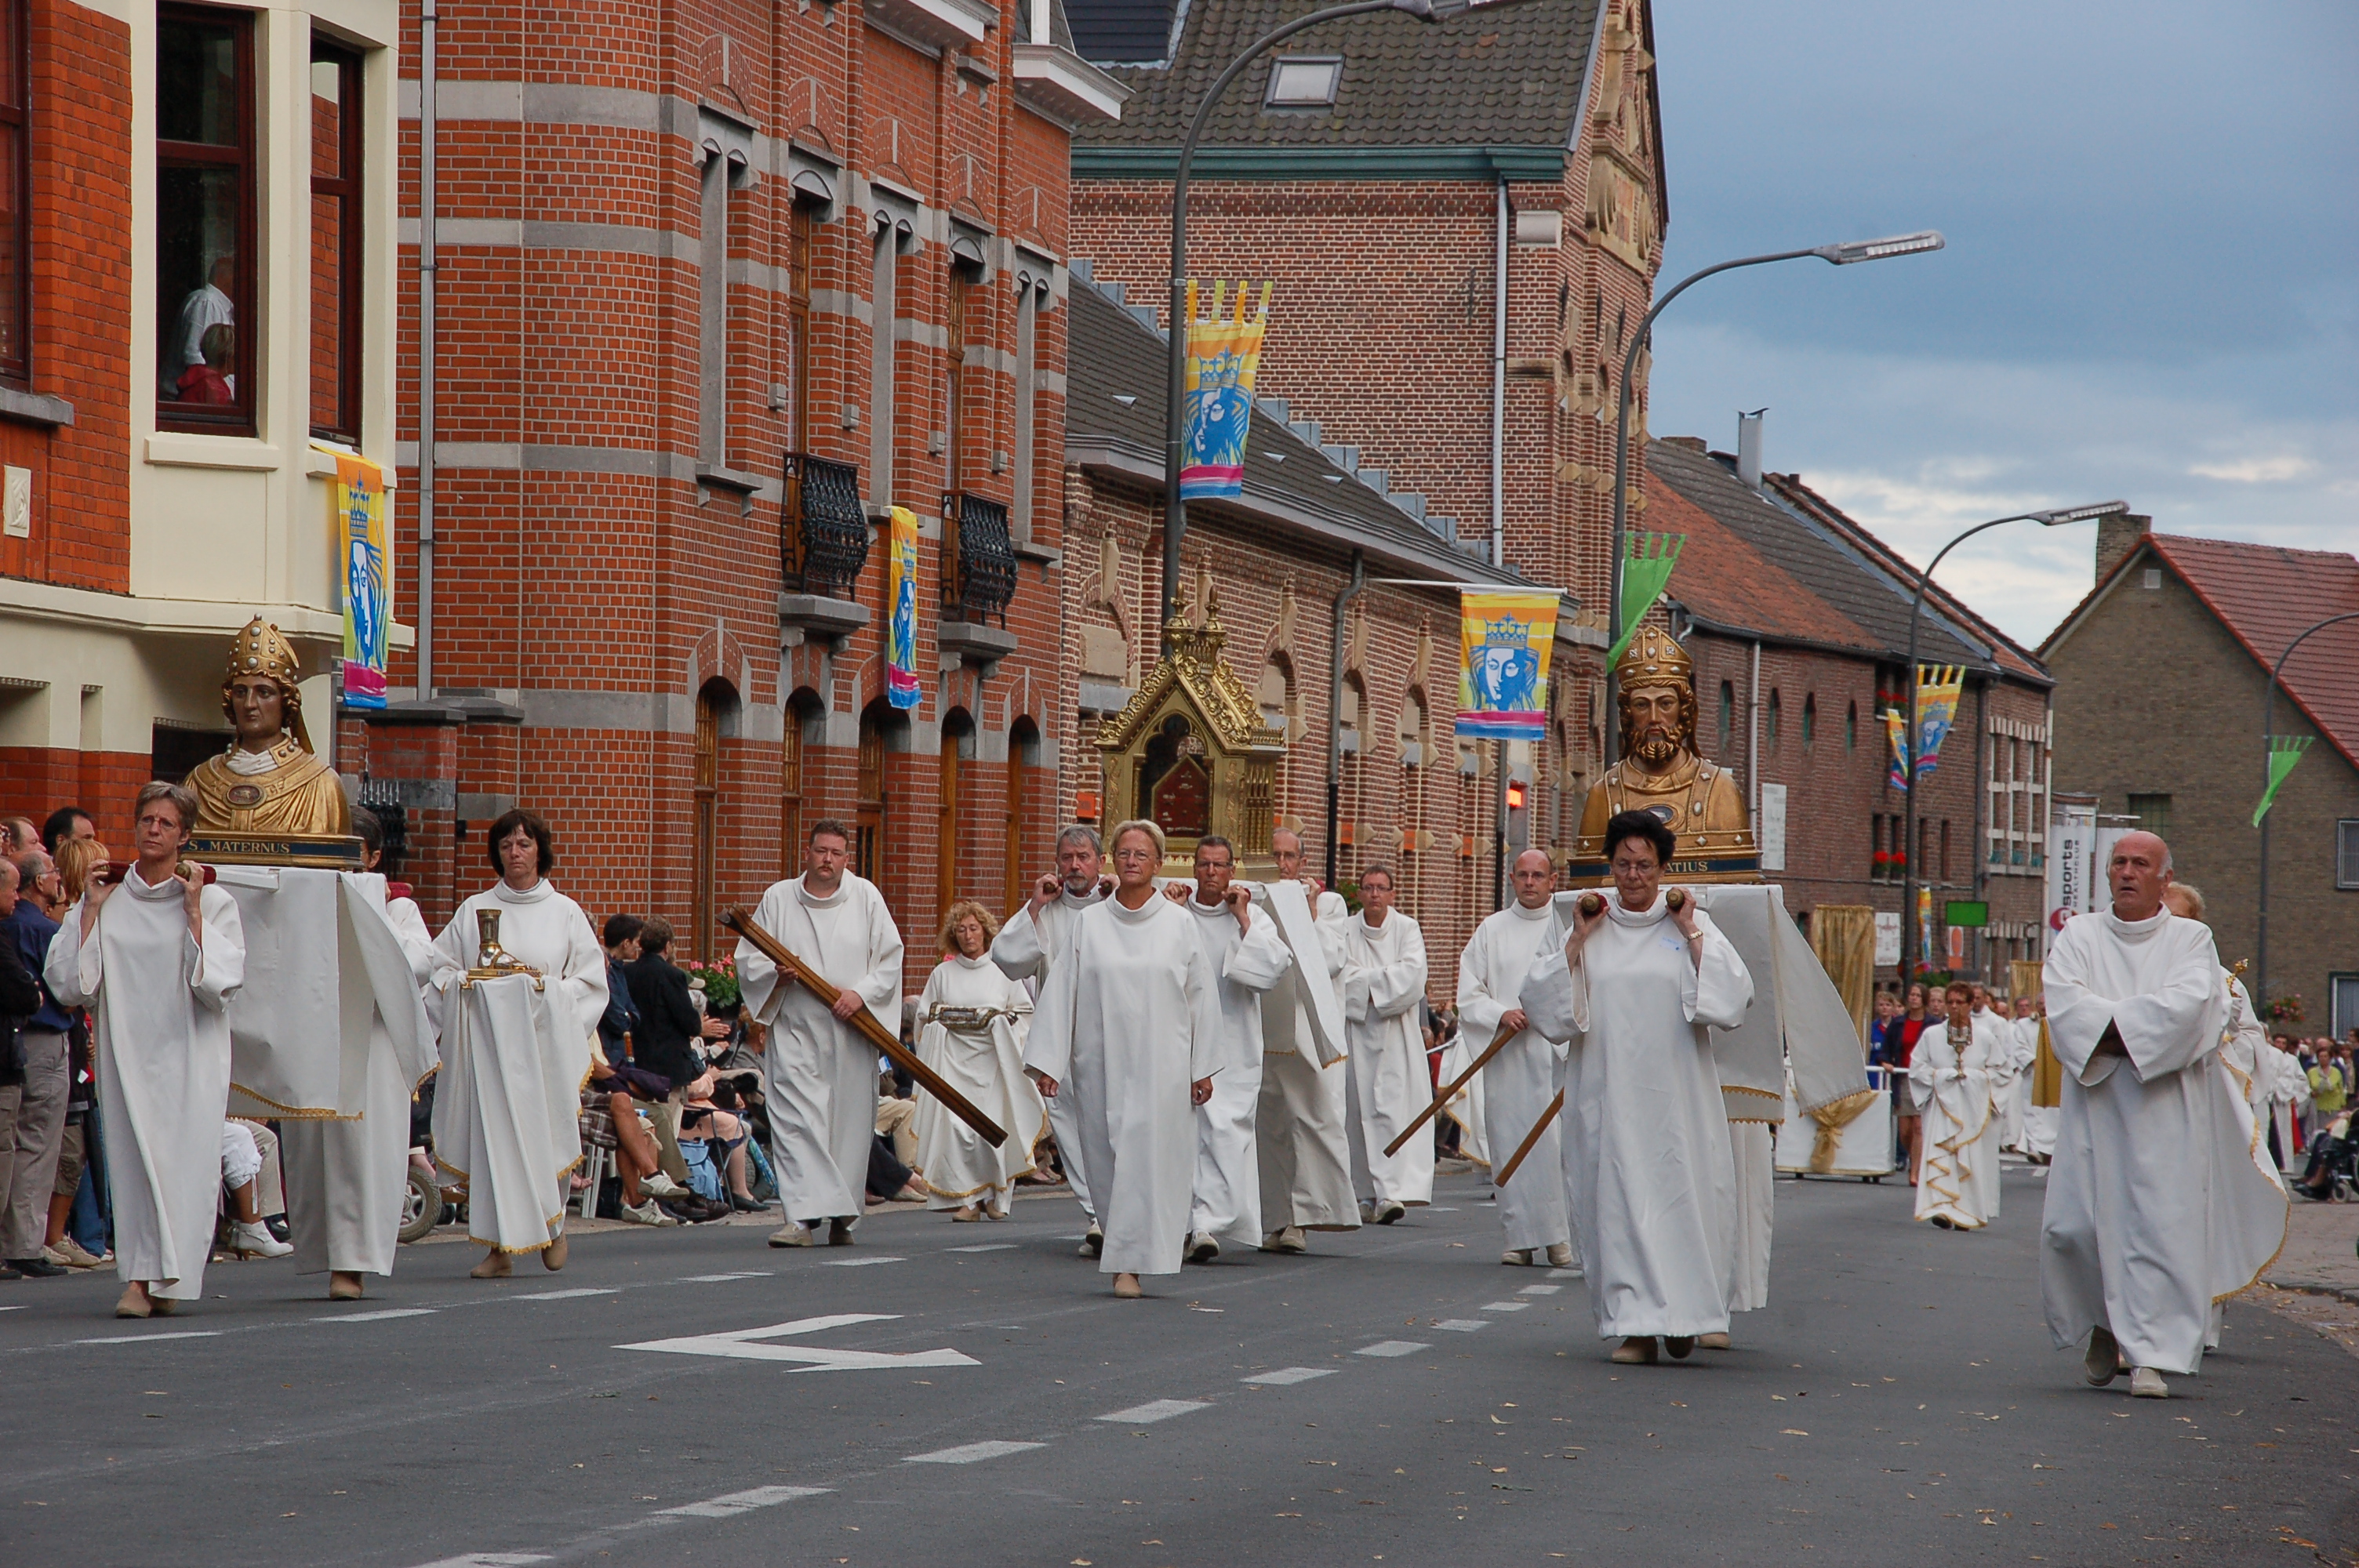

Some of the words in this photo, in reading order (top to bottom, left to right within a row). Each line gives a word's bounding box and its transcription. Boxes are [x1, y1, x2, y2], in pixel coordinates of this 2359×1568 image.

[188, 840, 204, 851] S.
[209, 840, 290, 854] MATERNUS
[1666, 861, 1708, 873] ATIUS
[2062, 839, 2074, 906] sports
